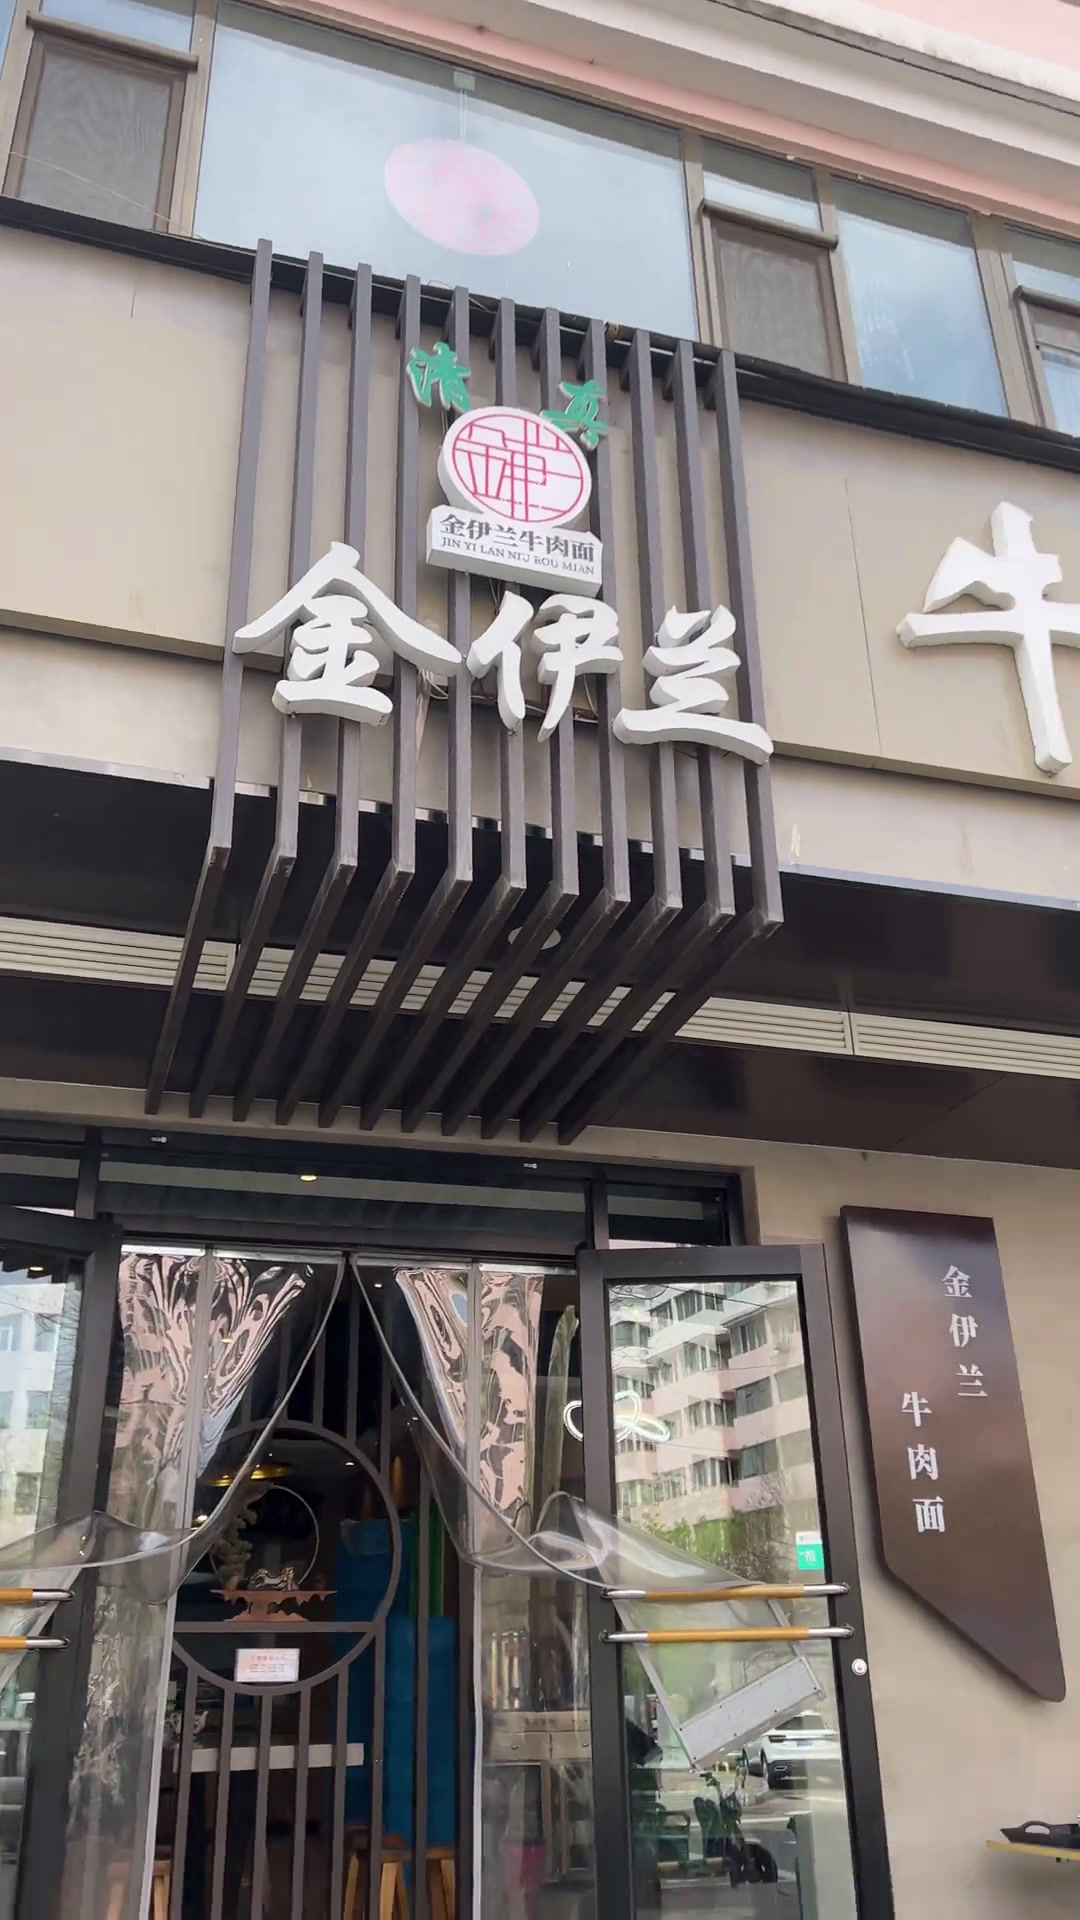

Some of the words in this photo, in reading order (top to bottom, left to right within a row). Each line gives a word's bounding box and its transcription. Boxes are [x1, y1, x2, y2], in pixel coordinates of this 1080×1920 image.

[440, 514, 594, 563] 金伊兰牛肉面
[441, 537, 461, 549] JIN
[464, 541, 477, 552] YI
[480, 545, 505, 558] LAN
[562, 561, 595, 575] MIAN
[234, 541, 774, 765] 金伊兰
[896, 501, 1080, 778] 牛
[942, 1265, 988, 1398] 金伊兰
[901, 1391, 946, 1534] 牛肉面
